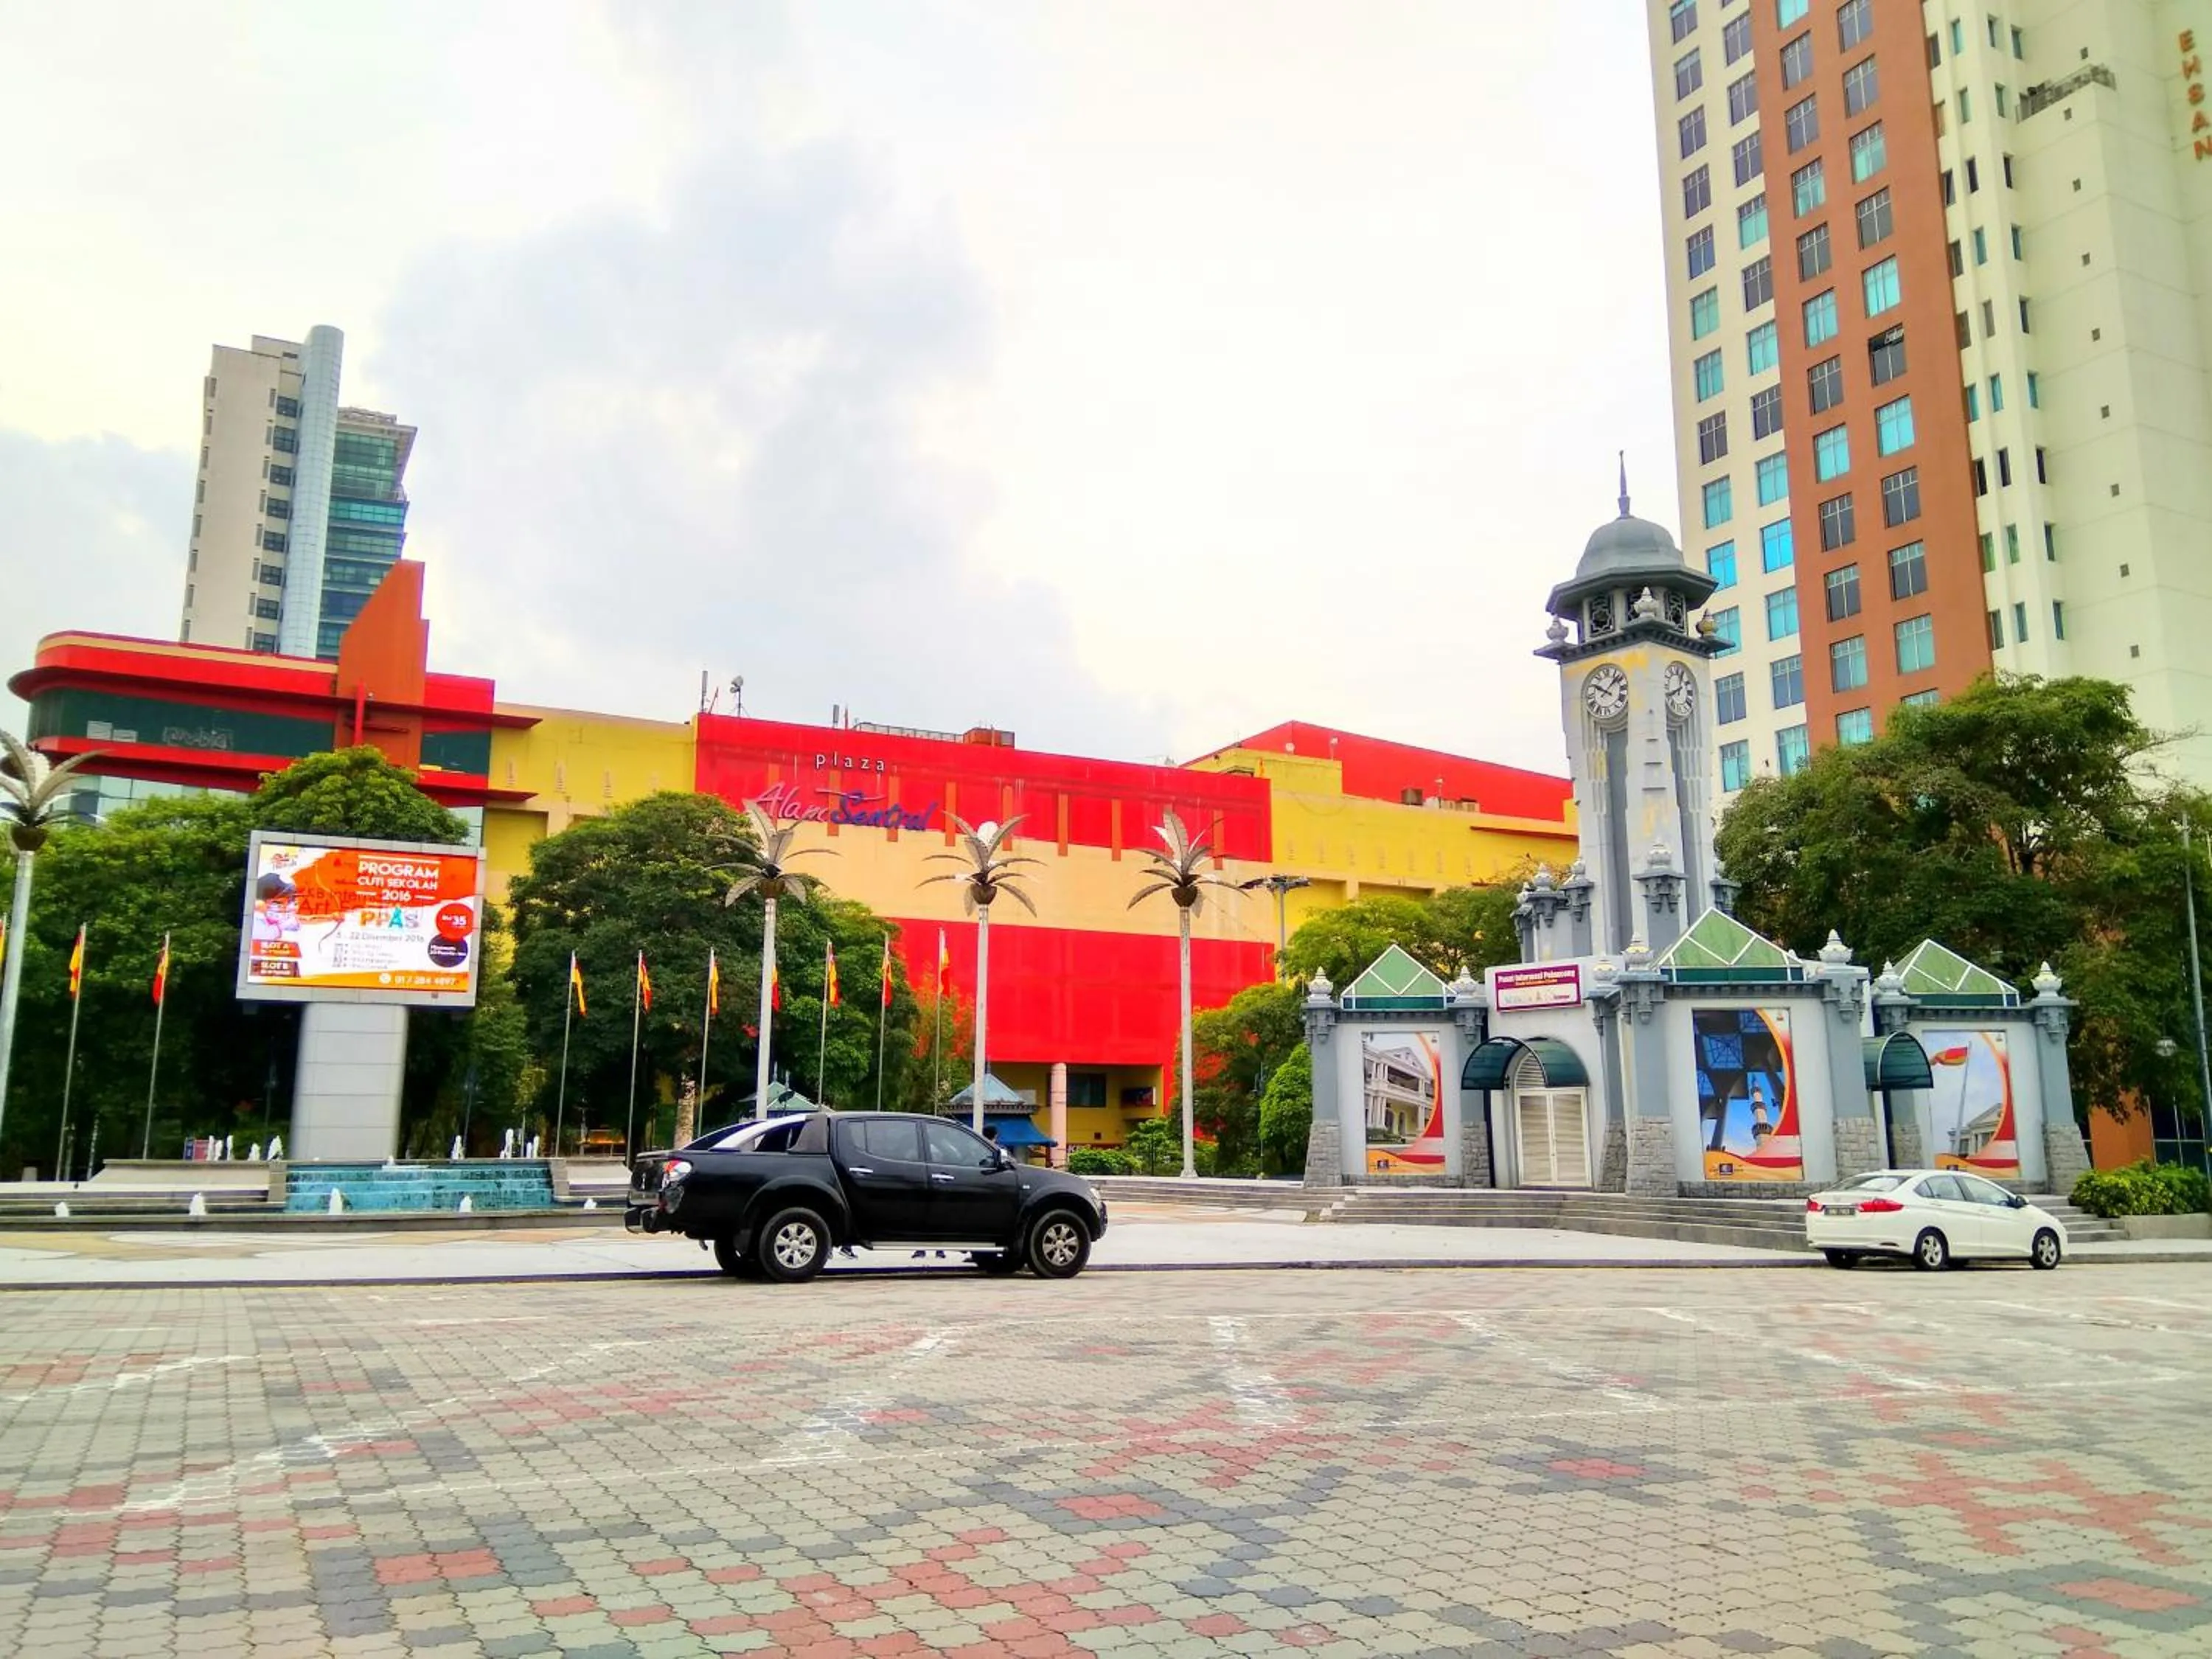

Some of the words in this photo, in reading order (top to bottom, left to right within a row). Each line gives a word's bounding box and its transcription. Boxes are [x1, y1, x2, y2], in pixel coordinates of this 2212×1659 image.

[2178, 28, 2212, 161] EHSAN
[815, 751, 886, 771] plaza
[755, 780, 829, 822] Alam
[830, 790, 939, 831] Sentral
[358, 860, 439, 879] PROGRAM
[357, 876, 384, 886] CUTI
[387, 878, 437, 890] SEKOLAH
[381, 889, 412, 902] 2016
[451, 915, 467, 927] 35
